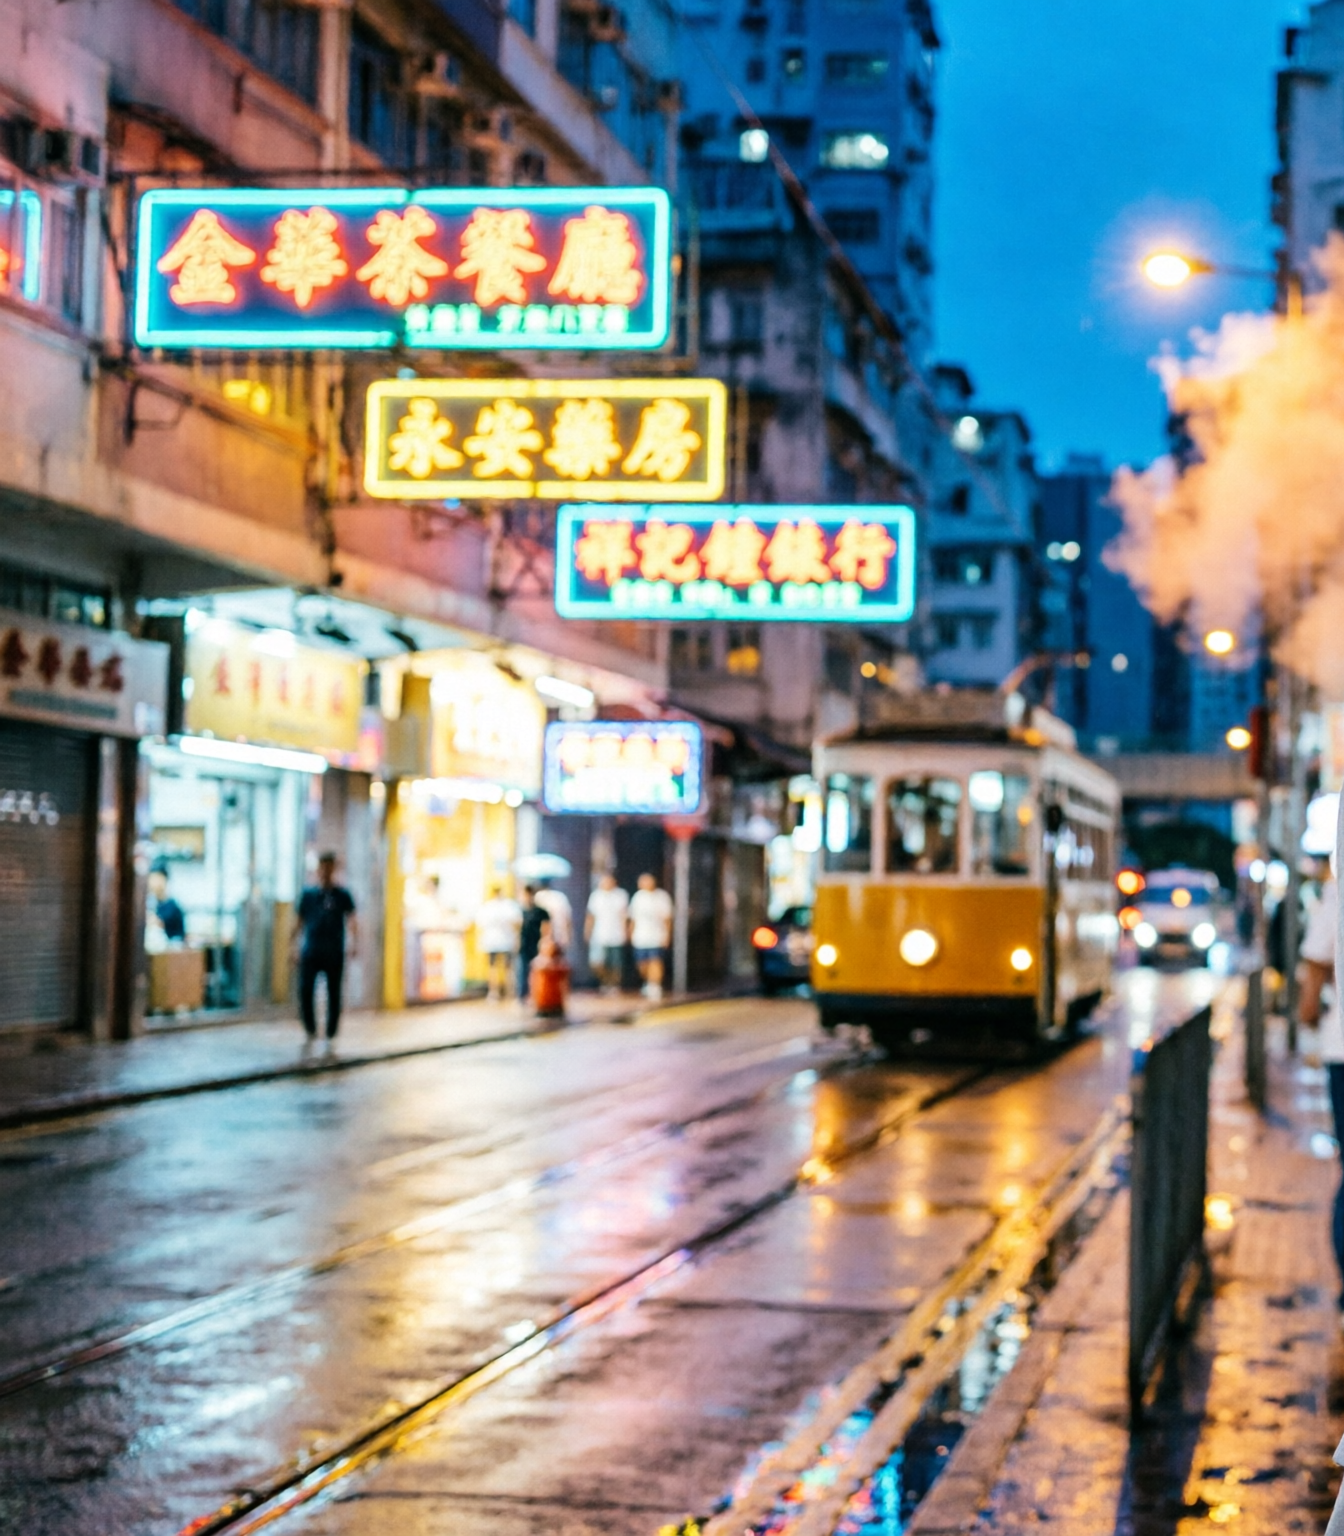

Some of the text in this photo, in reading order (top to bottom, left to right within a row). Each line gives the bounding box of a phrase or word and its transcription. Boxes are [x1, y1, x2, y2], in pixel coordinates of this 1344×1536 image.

[158, 206, 645, 306] 金華茶餐廳
[388, 396, 702, 483] 永安藥房
